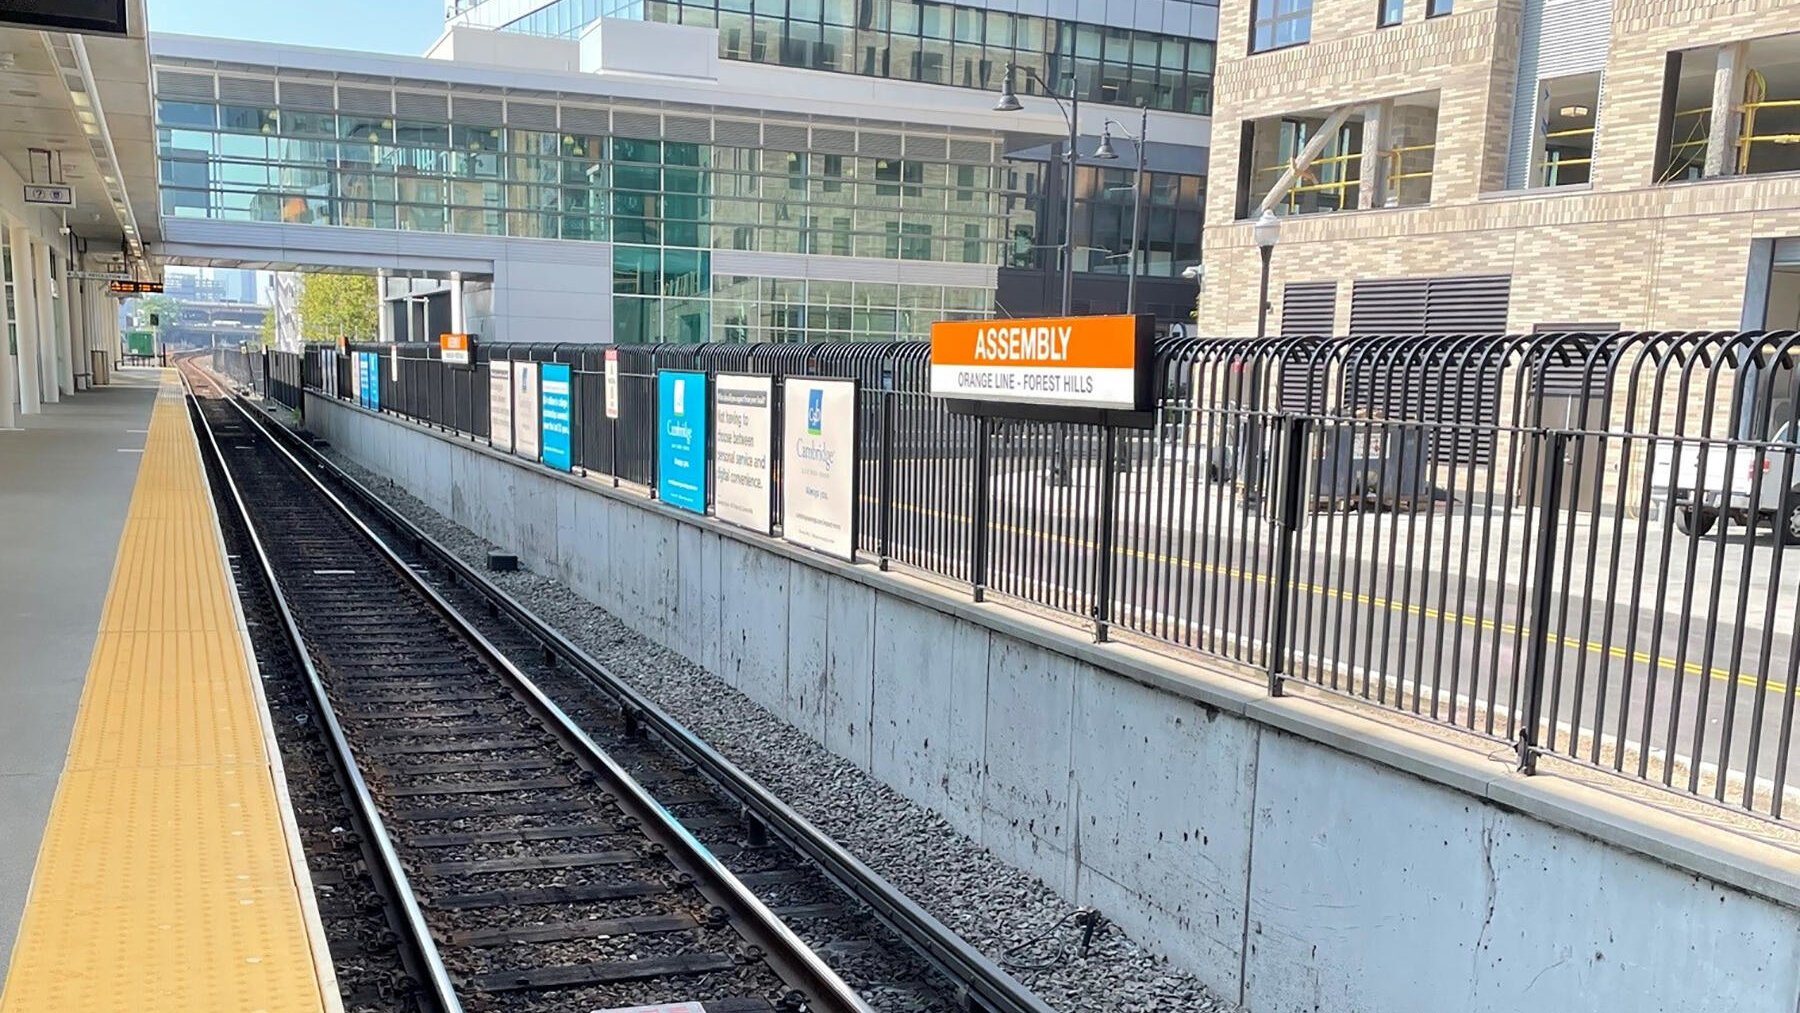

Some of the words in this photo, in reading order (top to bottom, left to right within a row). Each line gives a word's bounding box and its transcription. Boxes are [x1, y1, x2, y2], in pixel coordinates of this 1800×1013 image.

[974, 326, 1072, 361] ASSEMBLY
[958, 371, 994, 388] ORANGE
[995, 374, 1015, 390] LINE
[1024, 374, 1060, 392] FOREST
[1064, 375, 1093, 393] HILLS
[735, 453, 753, 466] service
[754, 455, 766, 469] and
[796, 438, 835, 471] Cambridge
